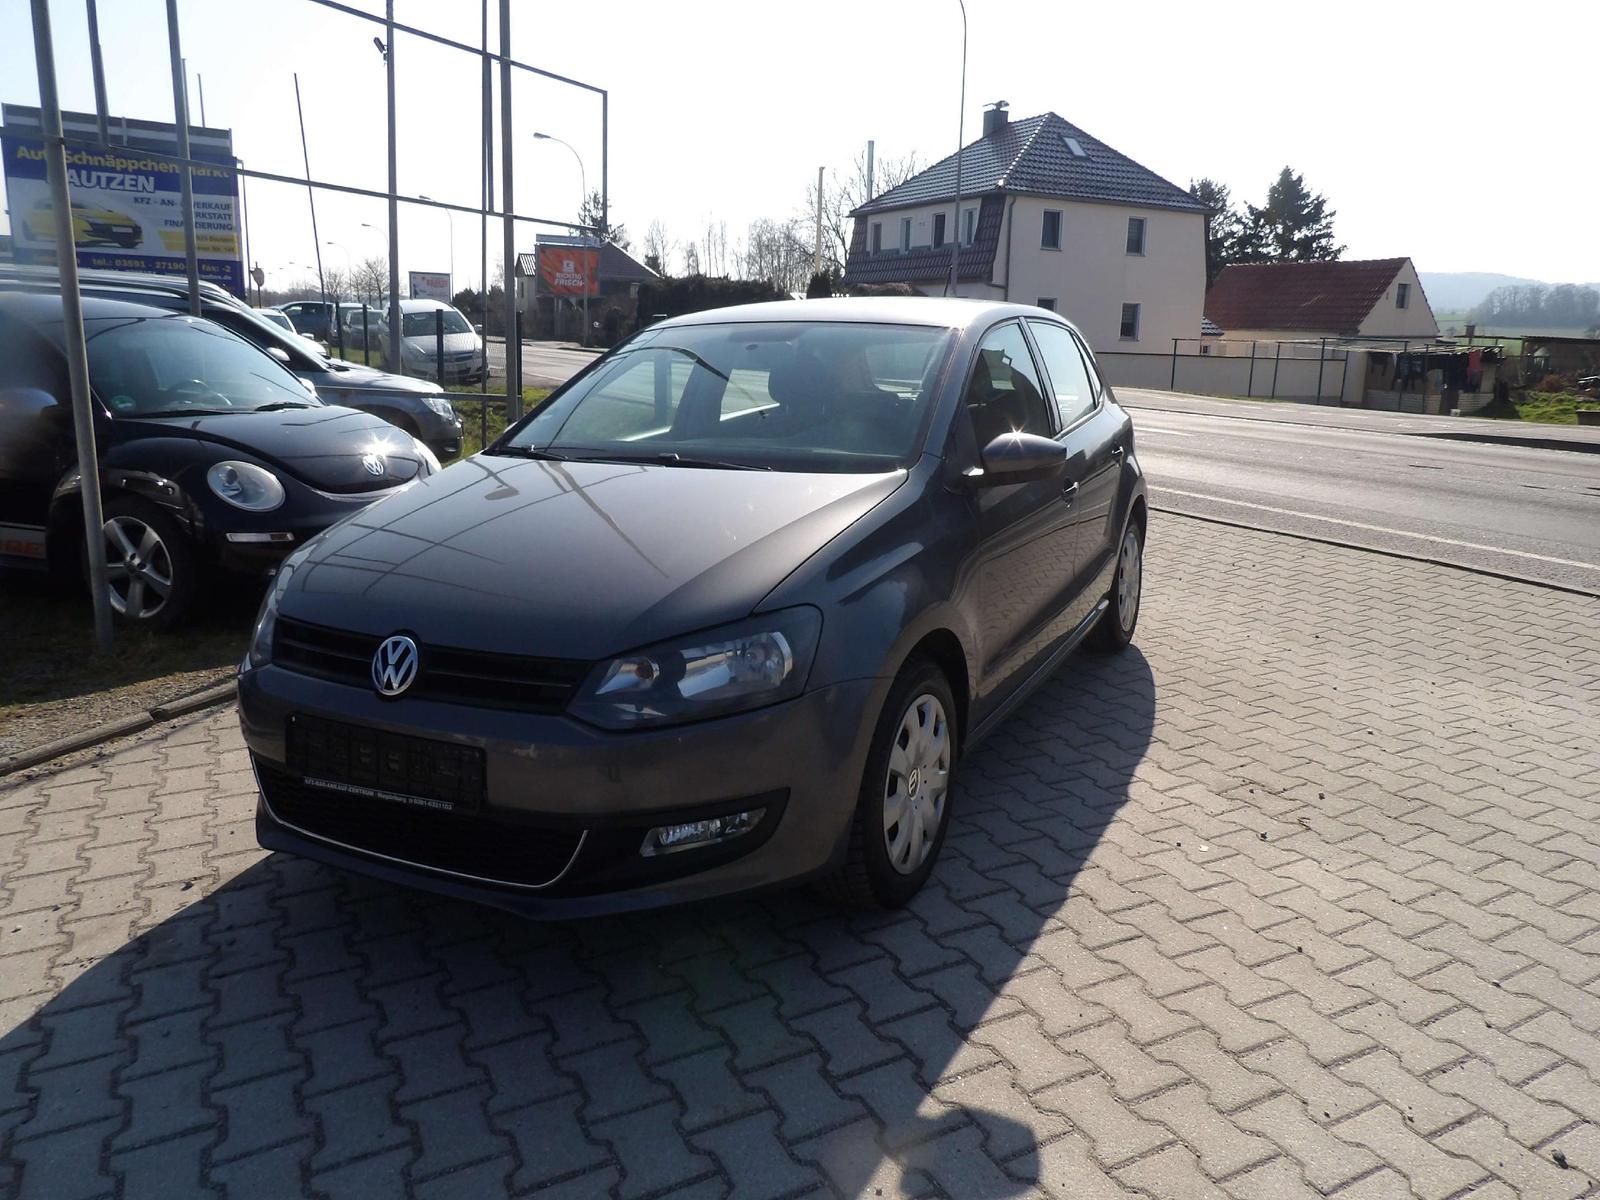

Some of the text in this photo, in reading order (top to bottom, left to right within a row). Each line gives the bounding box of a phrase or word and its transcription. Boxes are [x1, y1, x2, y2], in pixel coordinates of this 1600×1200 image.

[66, 171, 154, 192] AUTZEN
[133, 196, 152, 206] KFZ
[164, 219, 233, 231] FINAZIERUNG
[372, 635, 418, 696] VW
